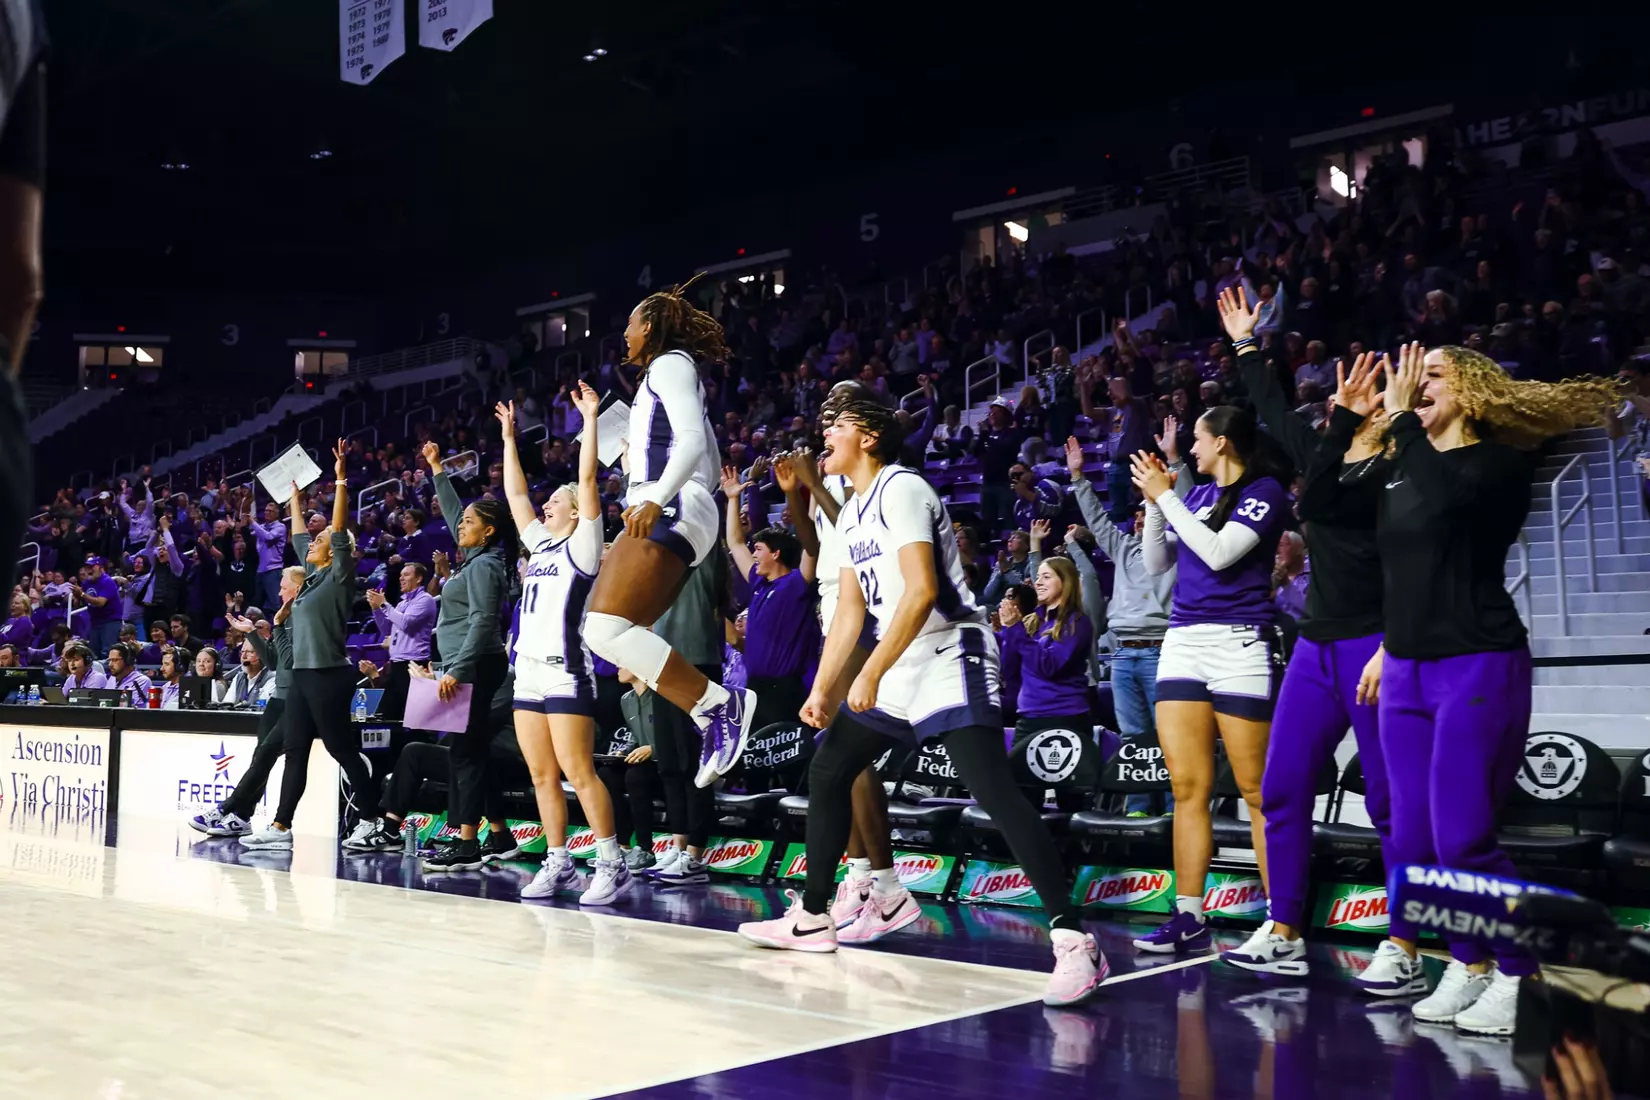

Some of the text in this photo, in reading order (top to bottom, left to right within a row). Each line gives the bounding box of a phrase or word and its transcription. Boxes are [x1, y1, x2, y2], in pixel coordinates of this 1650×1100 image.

[348, 18, 366, 33] 1973
[349, 6, 366, 21] 1972
[427, 7, 447, 23] 2013
[347, 43, 365, 57] 1975
[348, 31, 365, 45] 1974
[346, 56, 364, 69] 1976
[1169, 142, 1194, 170] 6
[860, 212, 880, 242] 5
[637, 264, 653, 289] 4
[221, 323, 240, 346] 3
[437, 312, 450, 335] 3
[1237, 497, 1271, 522] 33
[523, 583, 539, 614] 11
[860, 567, 883, 607] 32
[12, 731, 102, 766] Ascension
[744, 726, 803, 752] Capitol
[742, 741, 800, 770] Federal
[1118, 743, 1166, 763] Cap
[916, 755, 959, 779] Fede
[1117, 763, 1172, 782] Fede
[11, 772, 105, 810] Via Christi
[178, 779, 267, 806] FREED
[702, 843, 759, 865] LIBMAN
[970, 874, 1031, 898] LIBMA
[1084, 874, 1165, 905] LIBMAN
[1405, 866, 1501, 898] NEWS
[1202, 885, 1267, 912] LIBMA
[1326, 897, 1389, 926] LIBM
[1403, 900, 1498, 940] NEWS
